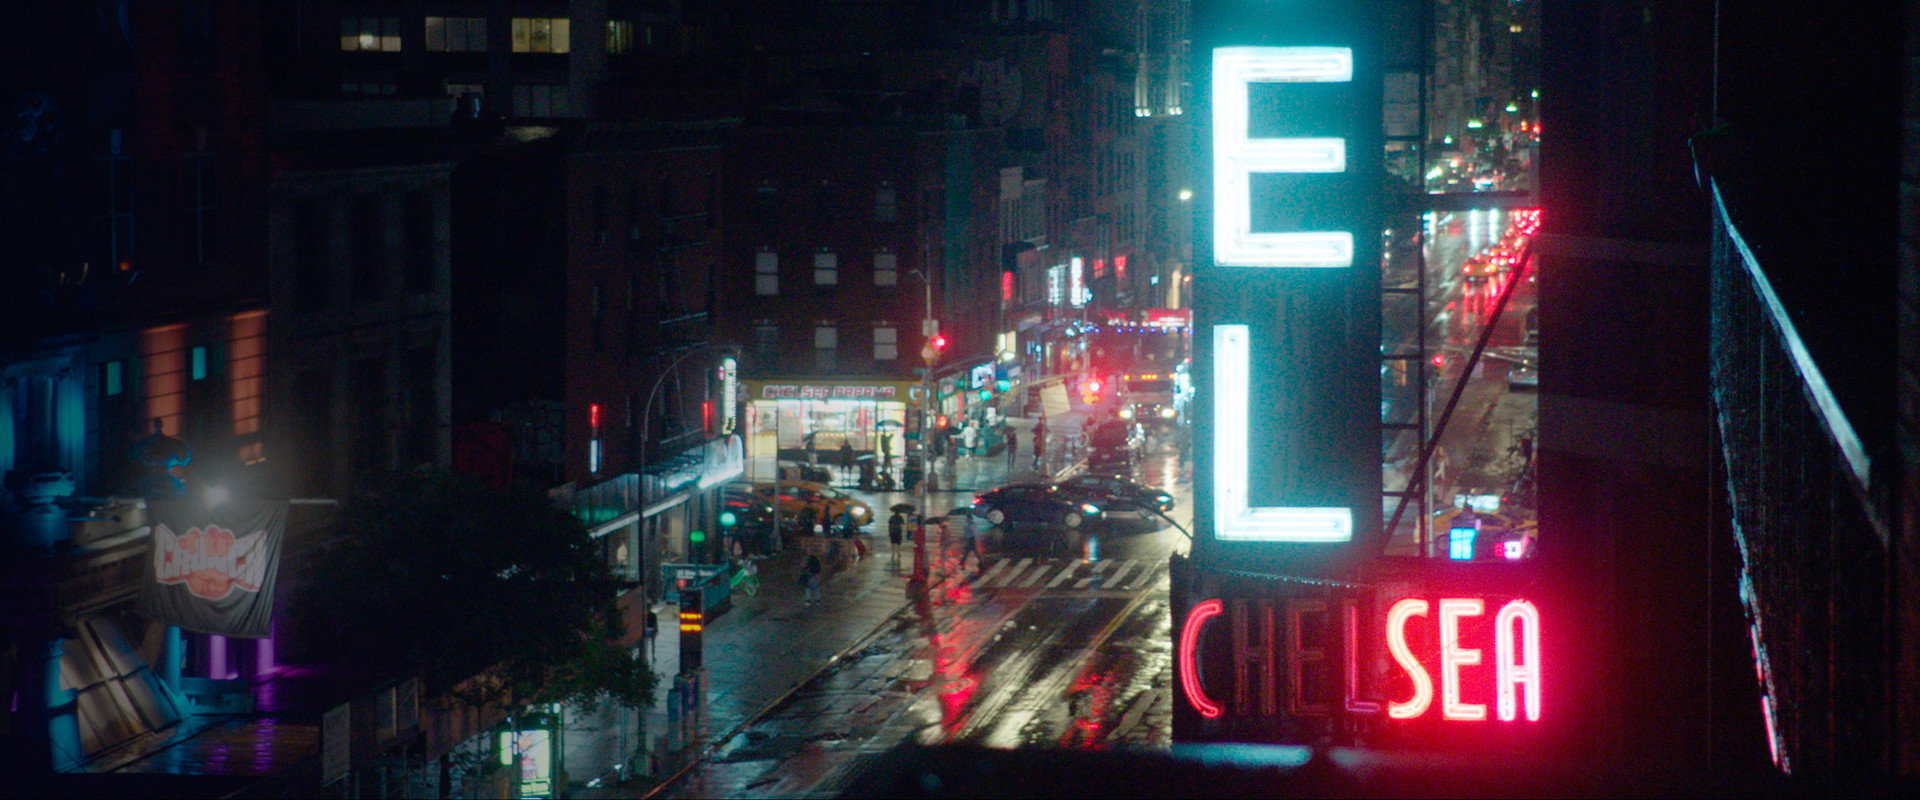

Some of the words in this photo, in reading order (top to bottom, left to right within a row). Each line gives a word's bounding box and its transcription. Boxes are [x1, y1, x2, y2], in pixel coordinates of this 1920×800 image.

[762, 384, 832, 400] CHELSEA
[154, 523, 267, 592] CRUNCH
[1178, 597, 1542, 723] CHELSEA
